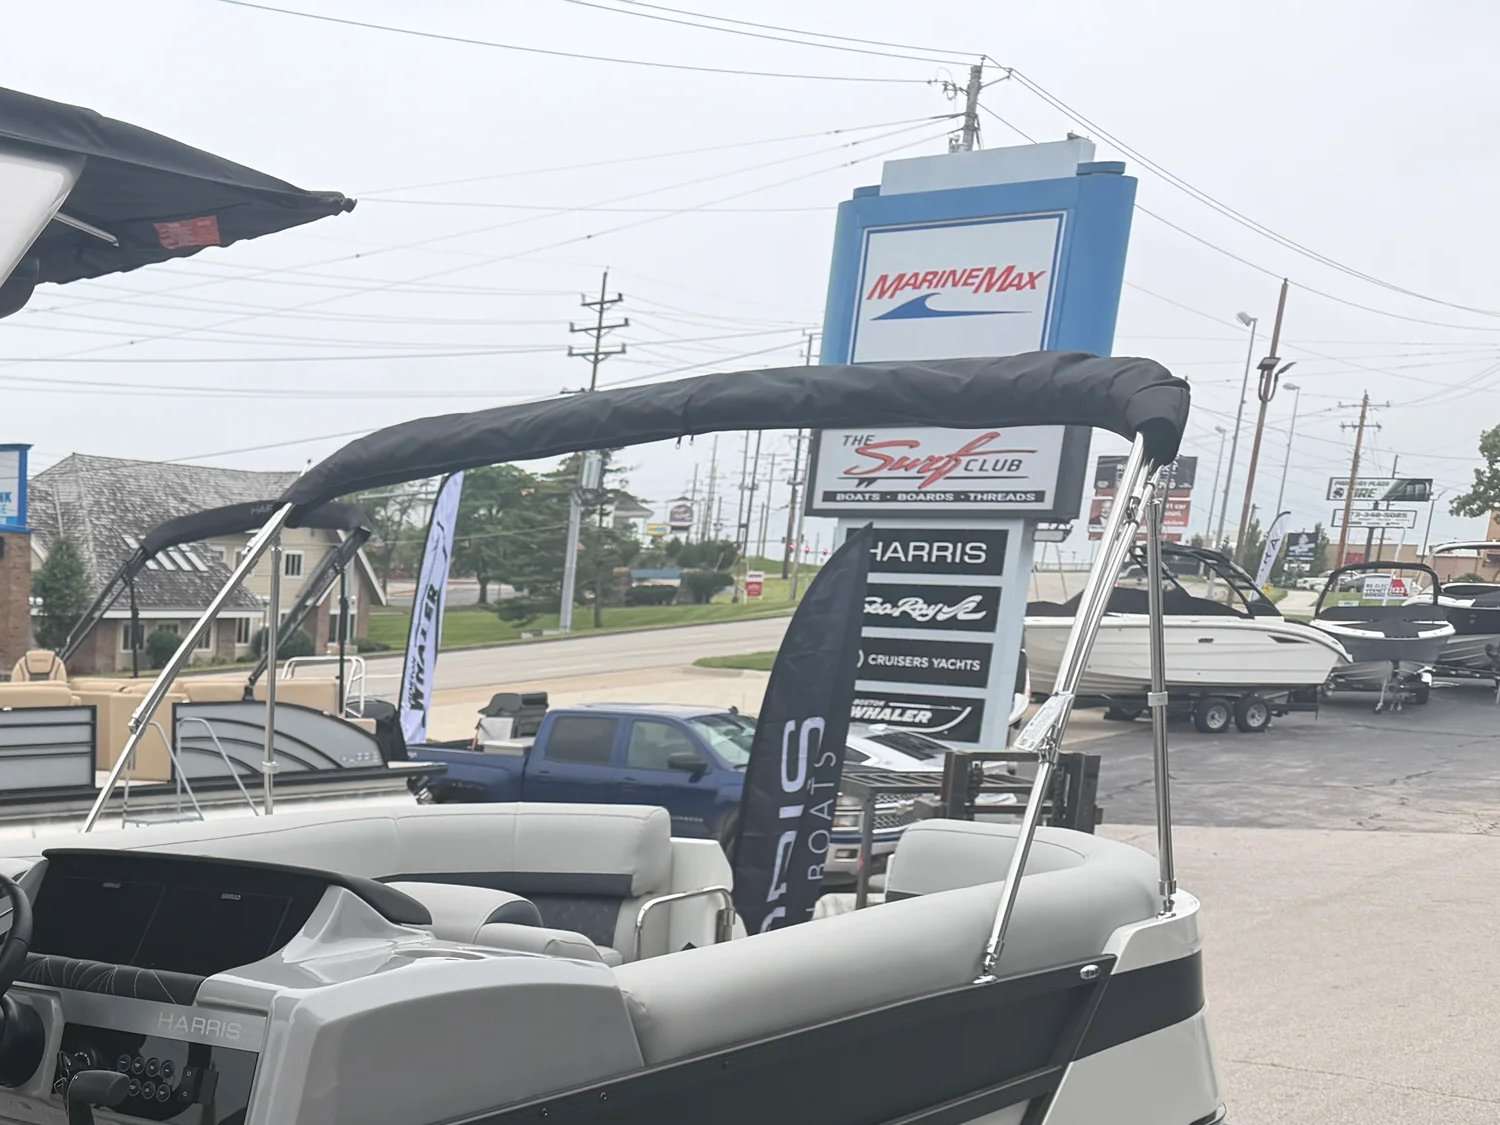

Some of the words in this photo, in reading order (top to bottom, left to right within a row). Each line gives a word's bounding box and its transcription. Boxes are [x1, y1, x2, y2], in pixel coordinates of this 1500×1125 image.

[866, 265, 1047, 300] MARINEMAX
[842, 435, 875, 446] THE
[844, 431, 1037, 489] Surf
[964, 459, 1023, 472] CLUB
[836, 493, 880, 502] BOATS
[897, 493, 954, 502] BOARDS
[969, 492, 1036, 502] THREADS
[868, 654, 929, 668] CRUISERS
[932, 658, 981, 671] YACHTS
[850, 706, 932, 724] WHALER
[808, 752, 836, 880] BOATS
[158, 1011, 242, 1039] HARRIS
